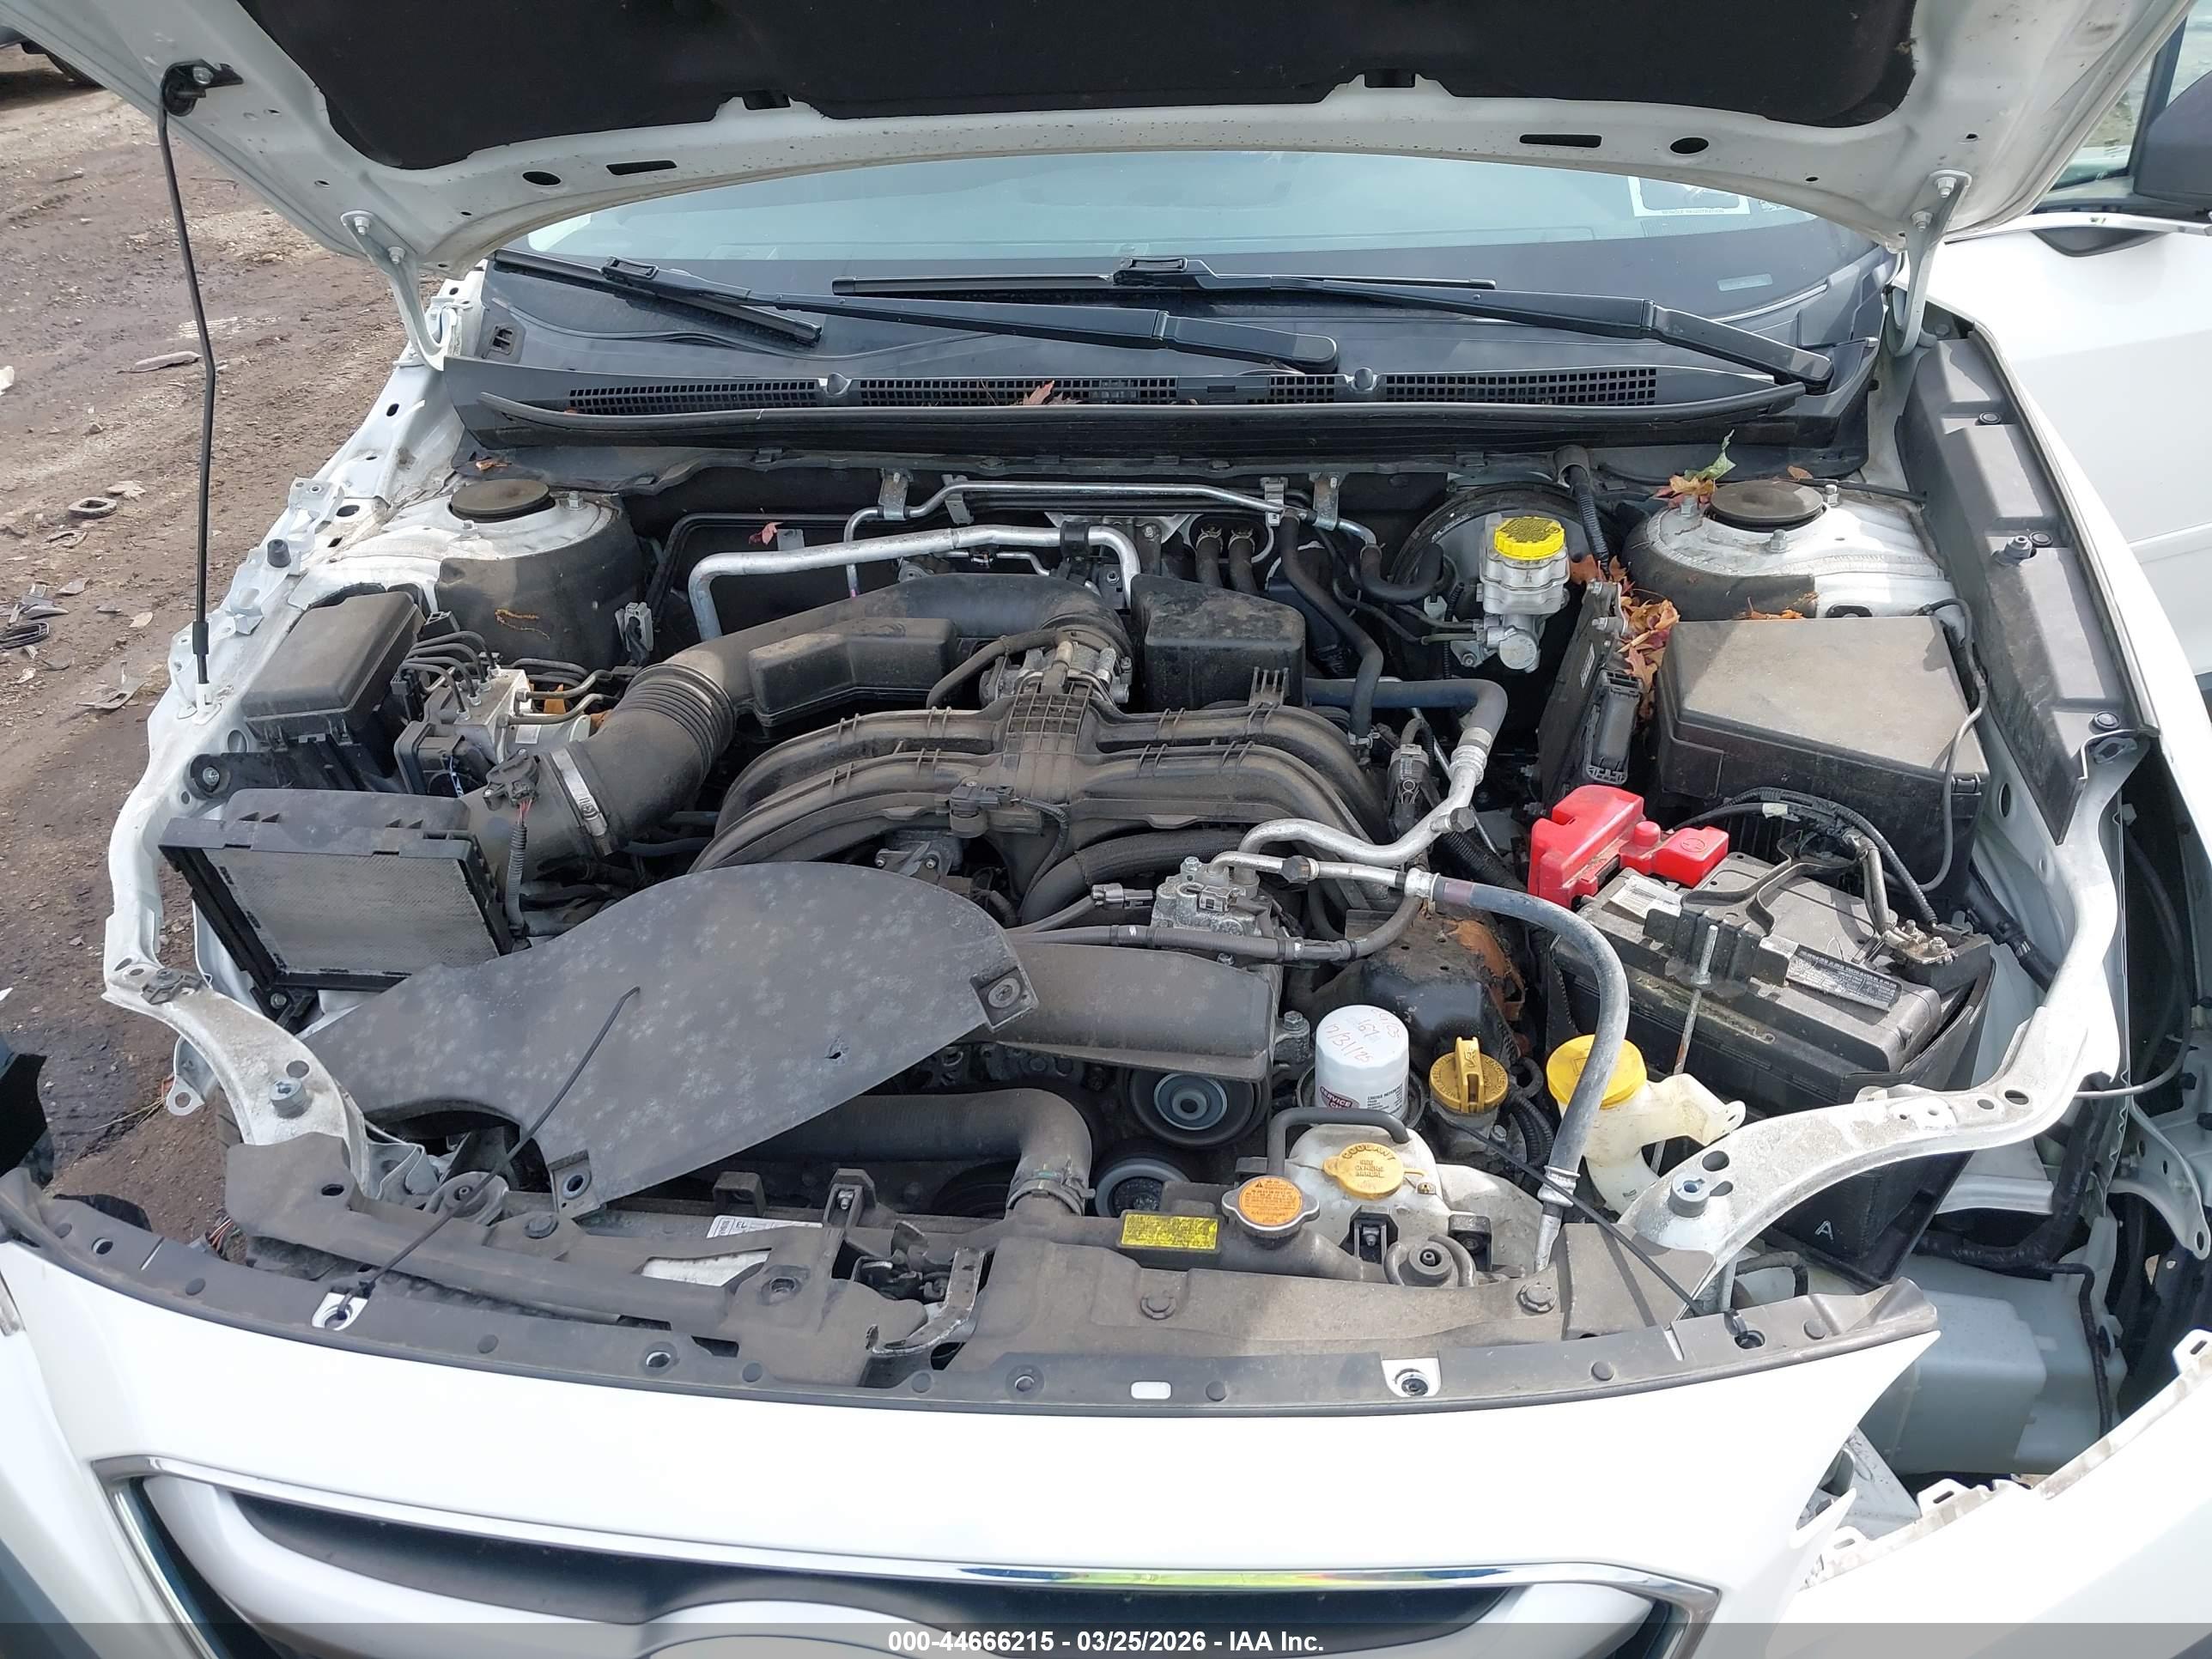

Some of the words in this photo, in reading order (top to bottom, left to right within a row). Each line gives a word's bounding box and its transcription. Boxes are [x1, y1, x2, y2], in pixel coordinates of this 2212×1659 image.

[1485, 1057, 1506, 1083] ENGINE
[1320, 1087, 1352, 1108] SERVICE
[1341, 1144, 1396, 1160] COOLANT
